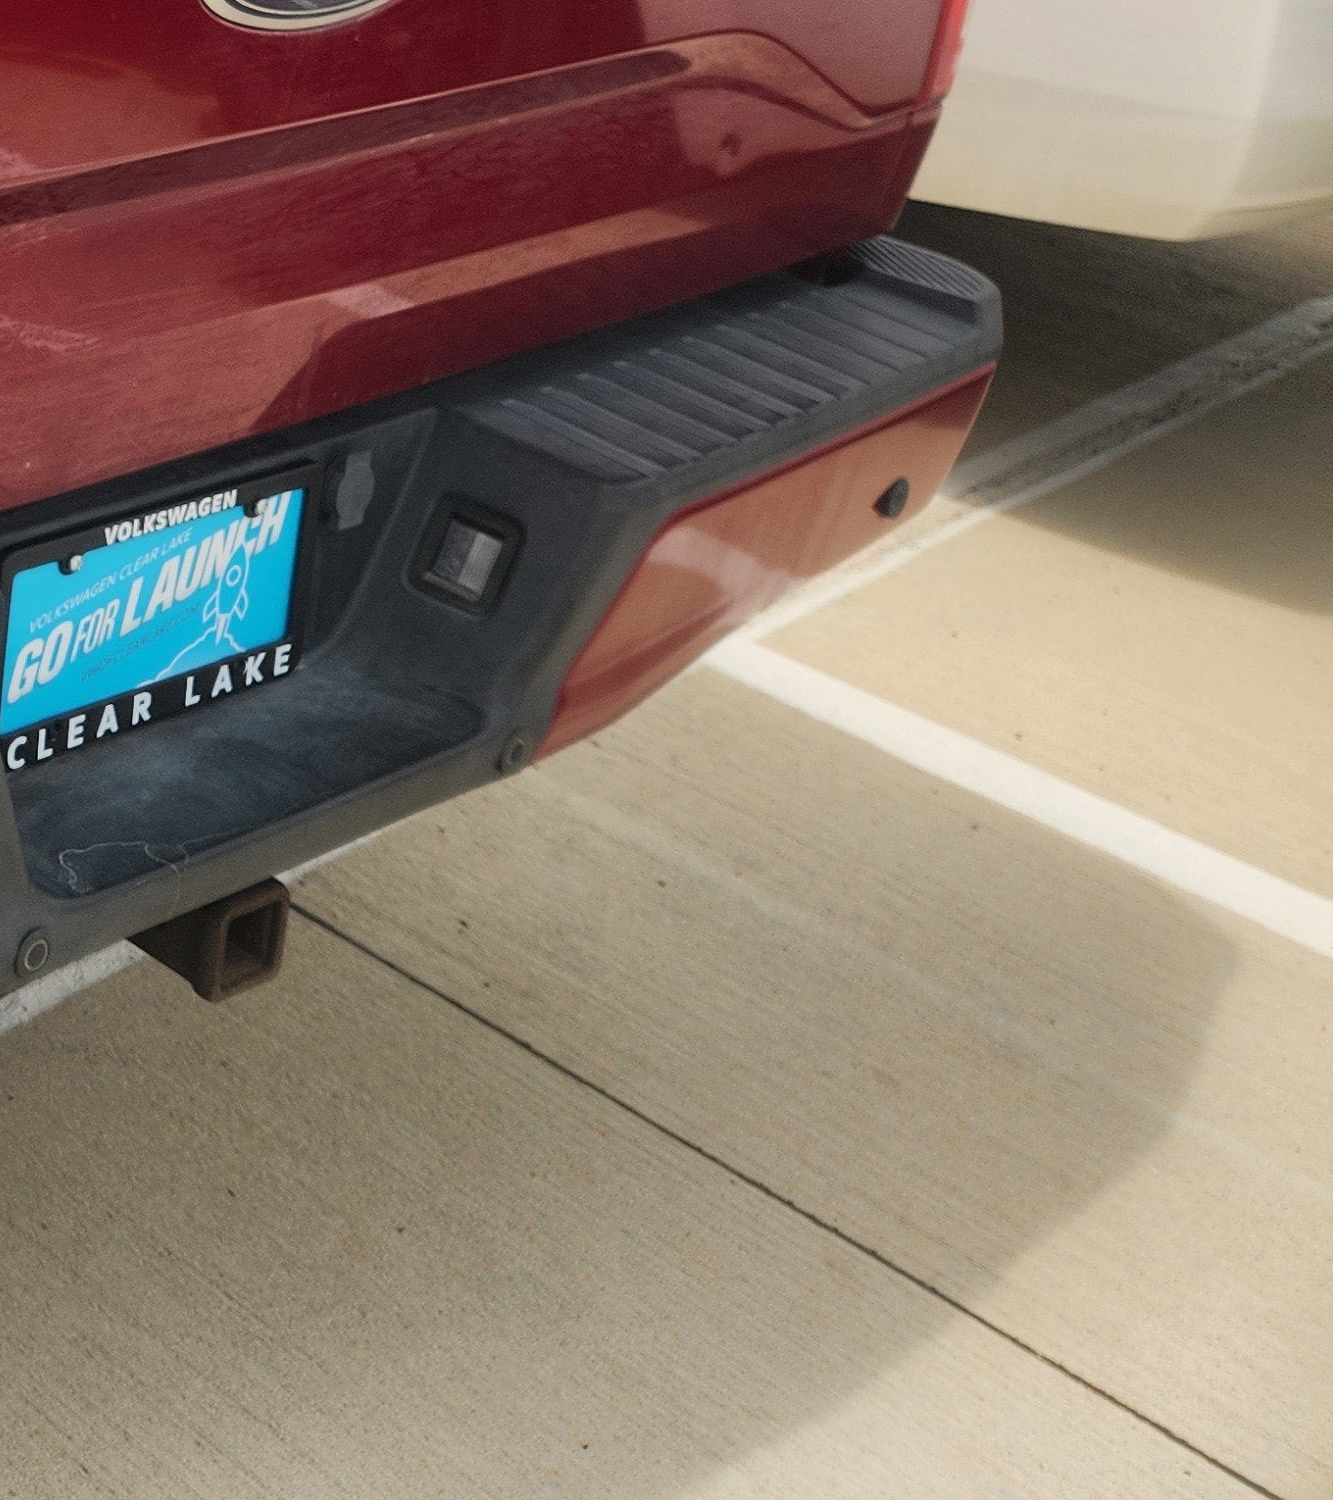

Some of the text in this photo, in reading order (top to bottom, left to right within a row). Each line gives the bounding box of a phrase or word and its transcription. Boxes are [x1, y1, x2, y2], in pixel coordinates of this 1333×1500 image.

[104, 489, 238, 546] VOLKSWAGEN
[7, 490, 293, 704] GO FOR LAUNCH
[29, 526, 194, 633] VOLKSWAGEN CLEAR LAKE
[7, 643, 293, 771] CLEAR LAKE
